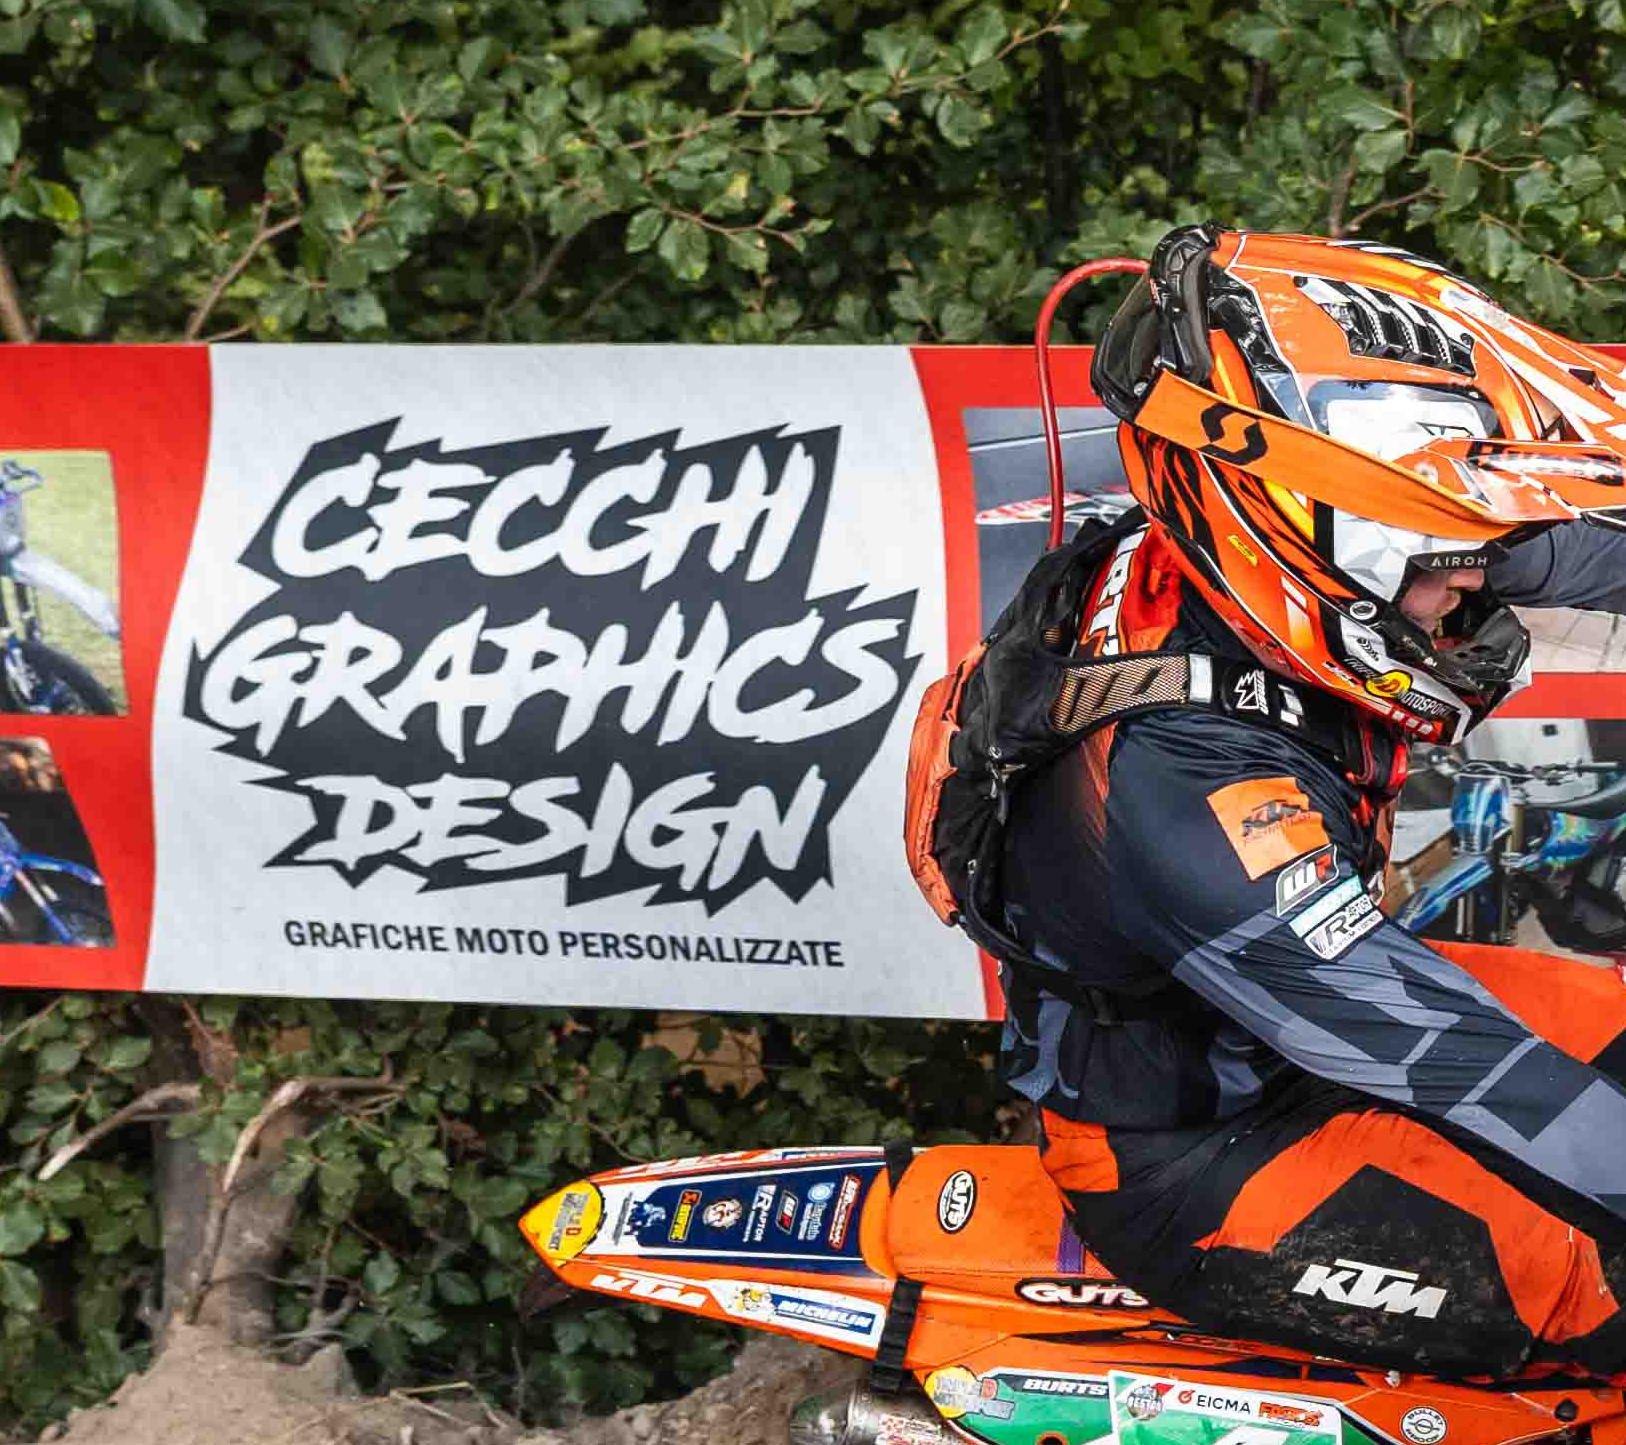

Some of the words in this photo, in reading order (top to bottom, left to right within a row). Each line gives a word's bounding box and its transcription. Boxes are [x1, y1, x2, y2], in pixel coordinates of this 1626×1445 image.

[272, 442, 817, 590] CECCHI
[1431, 556, 1487, 567] AIROH
[200, 601, 907, 763] GRAPHICS
[291, 762, 829, 891] DESIGN
[284, 921, 449, 953] GRAFICHE
[456, 926, 550, 956] MOTO
[560, 931, 845, 968] PERSONALIZZATE
[948, 1174, 972, 1227] GUTS
[590, 1272, 707, 1307] KTM
[1021, 1283, 1149, 1305] GUTS
[1293, 1258, 1447, 1319] KTM
[776, 1299, 872, 1328] MICHELIN
[1023, 1378, 1109, 1396] BURTS
[1197, 1394, 1250, 1414] EICMA
